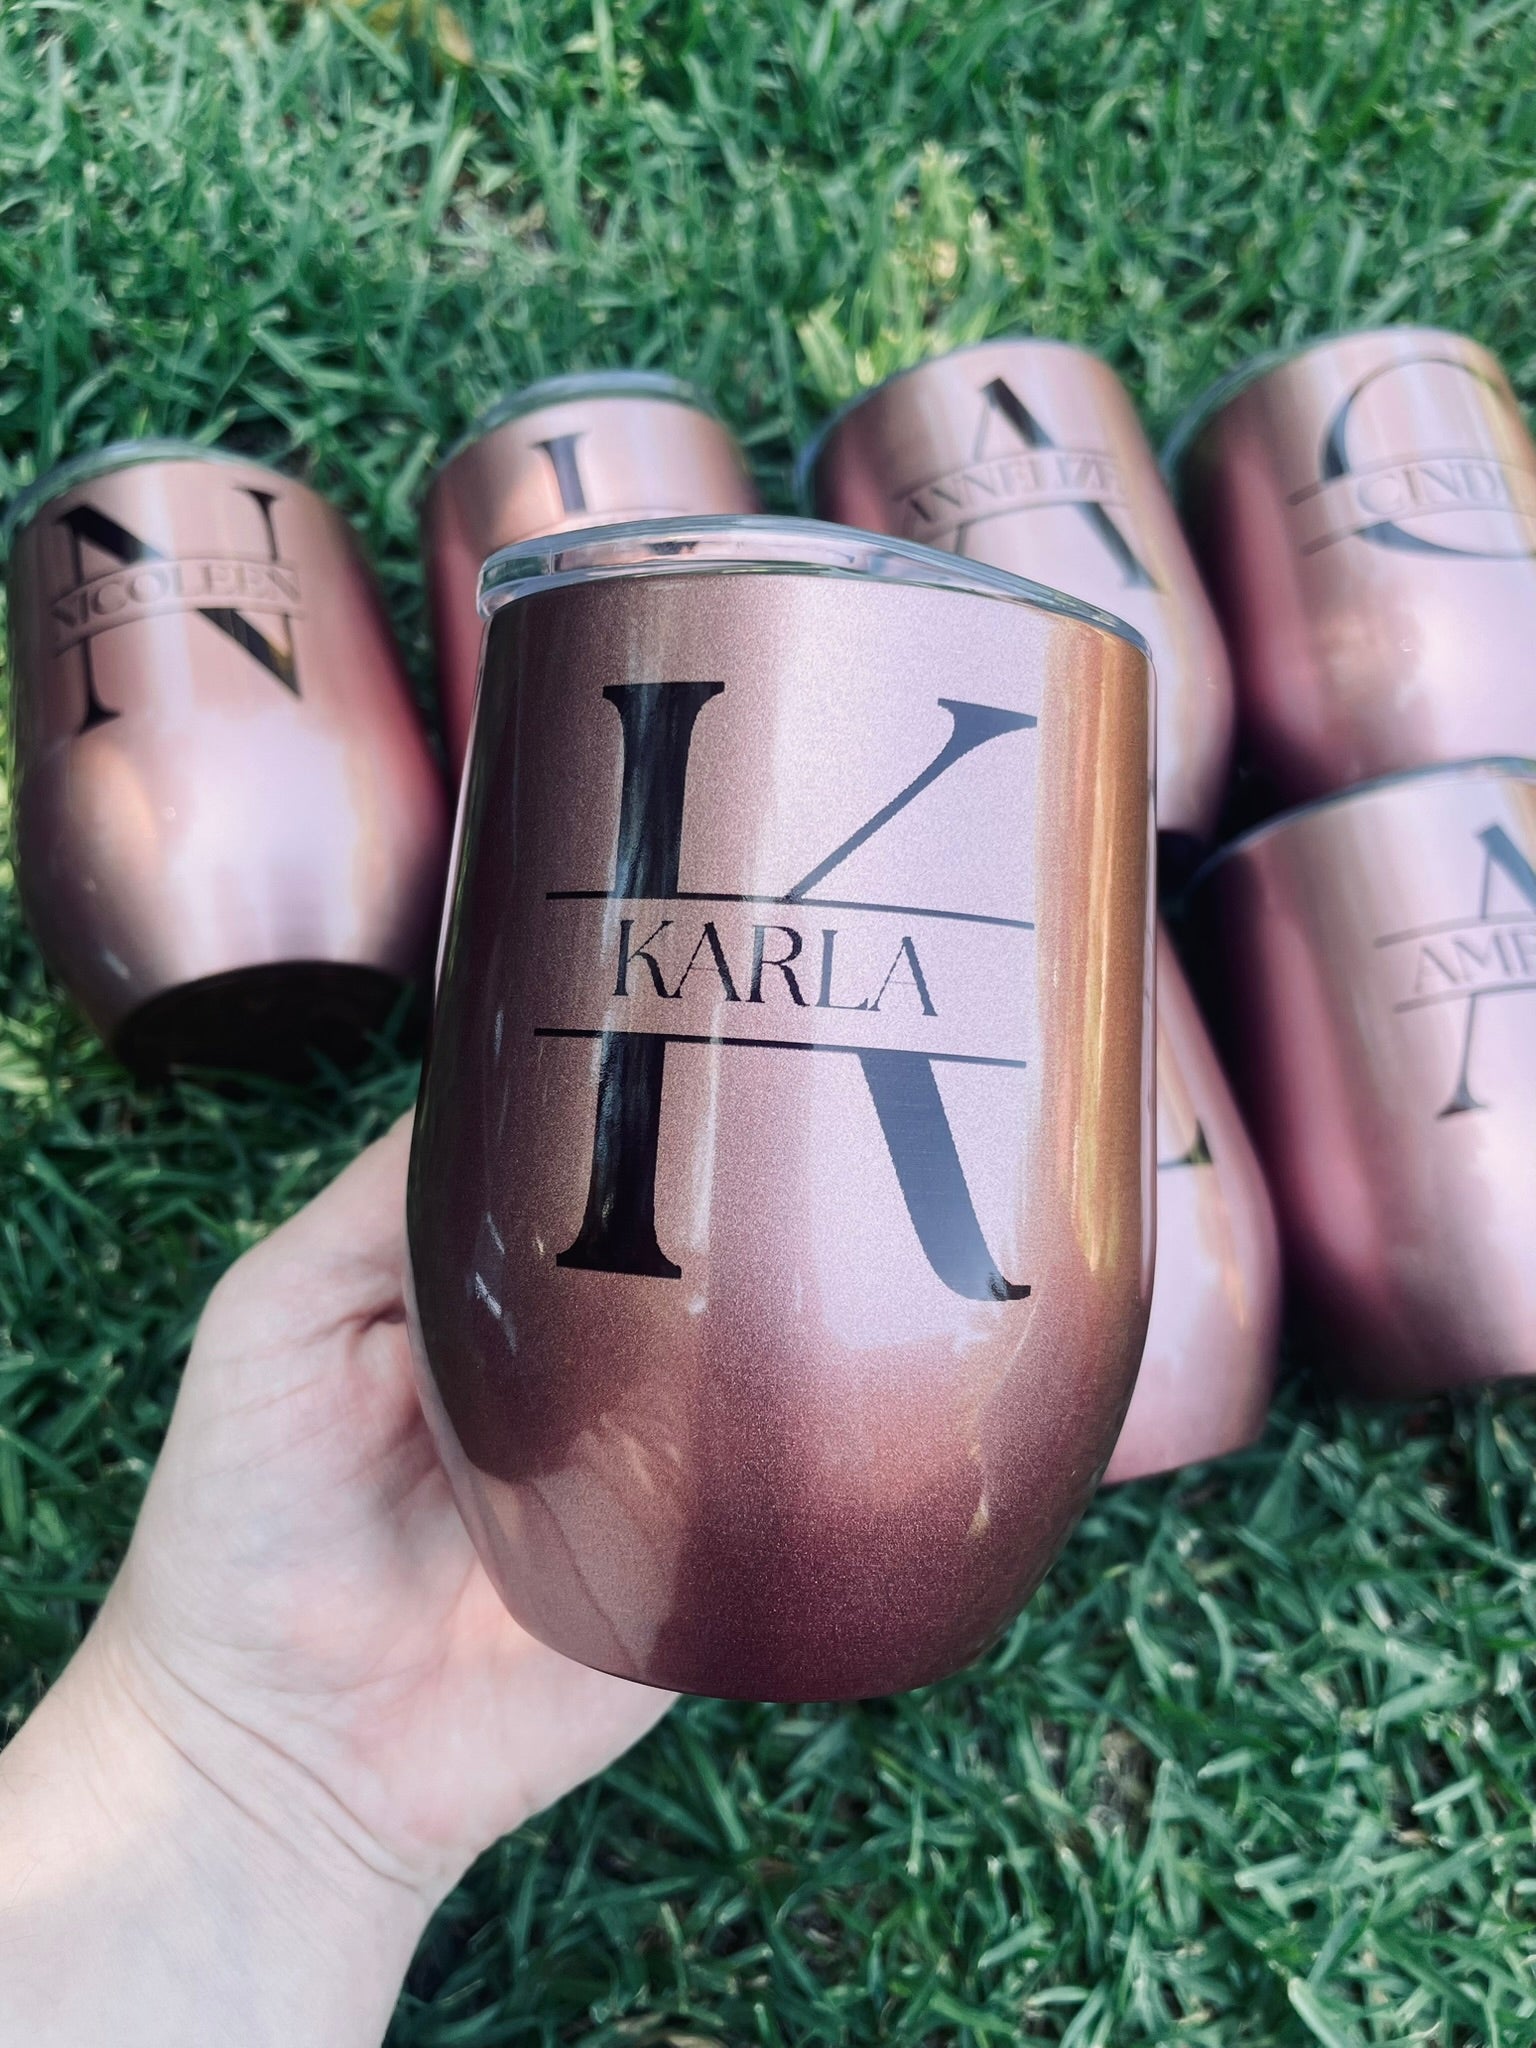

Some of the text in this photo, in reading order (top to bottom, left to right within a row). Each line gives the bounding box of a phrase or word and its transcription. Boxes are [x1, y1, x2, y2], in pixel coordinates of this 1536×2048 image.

[55, 485, 301, 735] N
[556, 681, 1037, 1301] K
[612, 920, 938, 1016] KARLA
